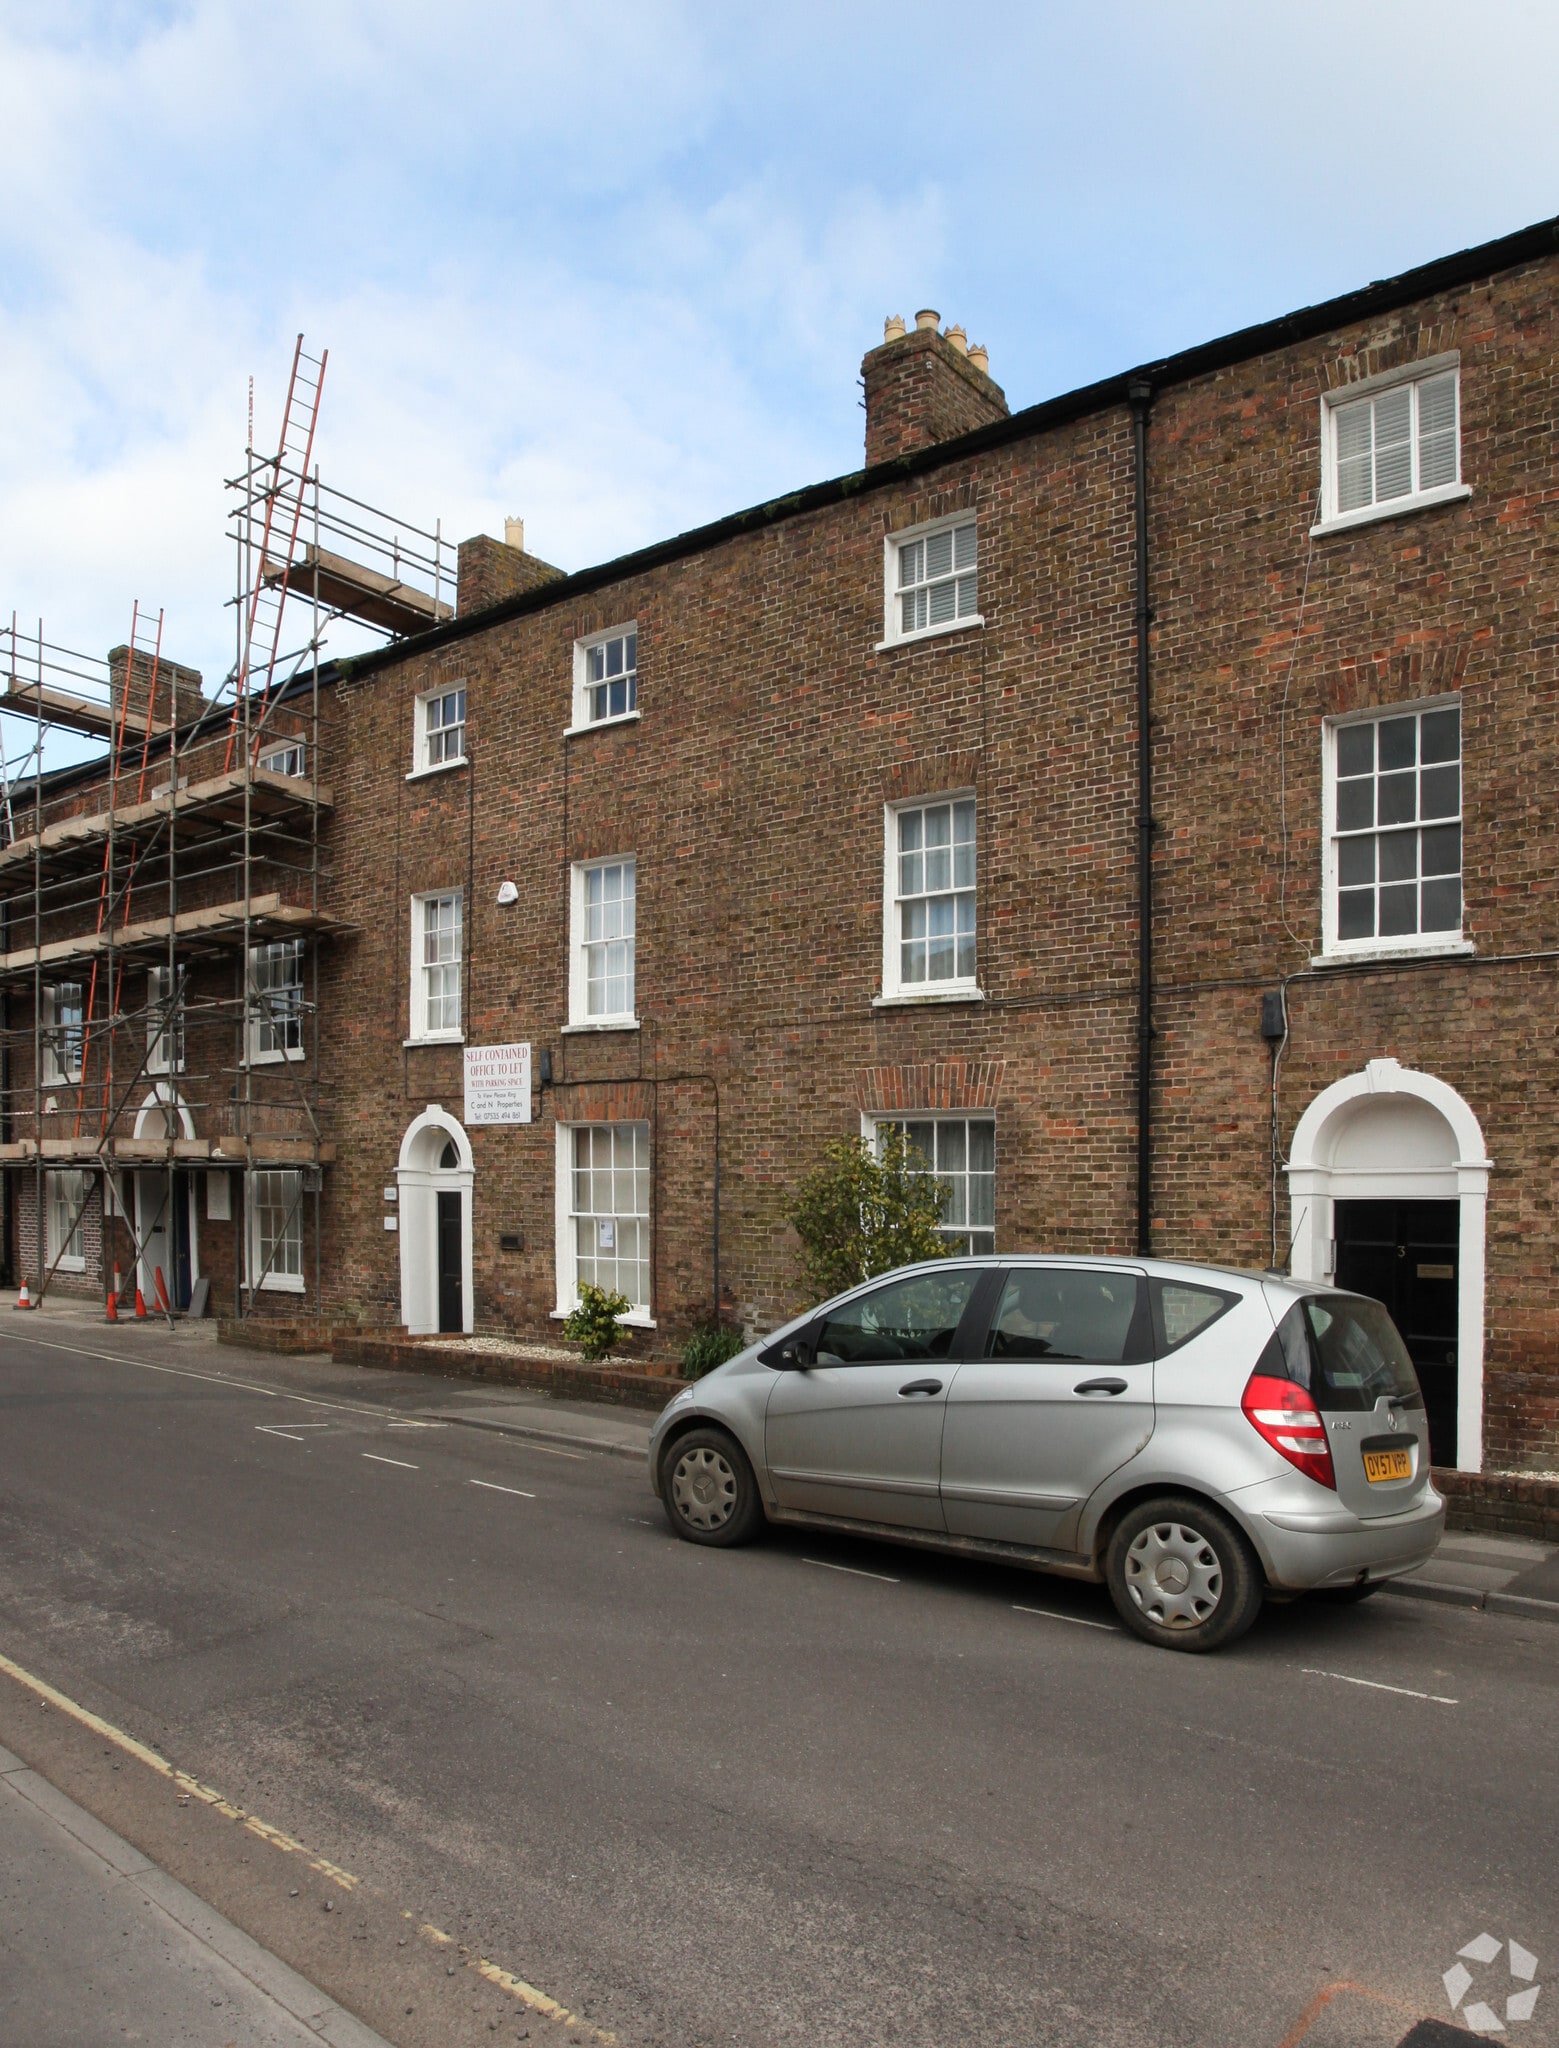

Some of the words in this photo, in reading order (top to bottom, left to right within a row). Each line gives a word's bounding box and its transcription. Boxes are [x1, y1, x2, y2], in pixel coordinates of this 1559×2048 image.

[466, 1051, 483, 1062] SELF
[485, 1047, 528, 1061] CONTAINED
[470, 1064, 495, 1076] OFFICE
[498, 1063, 507, 1075] TO
[509, 1062, 522, 1074] LET
[471, 1080, 484, 1088] WITH
[485, 1079, 506, 1087] PARKING
[508, 1077, 522, 1086] SPACE
[471, 1101, 475, 1109] C
[476, 1101, 486, 1109] and
[497, 1100, 522, 1109] Properties
[1397, 1245, 1406, 1258] 3
[1367, 1455, 1391, 1477] OY57
